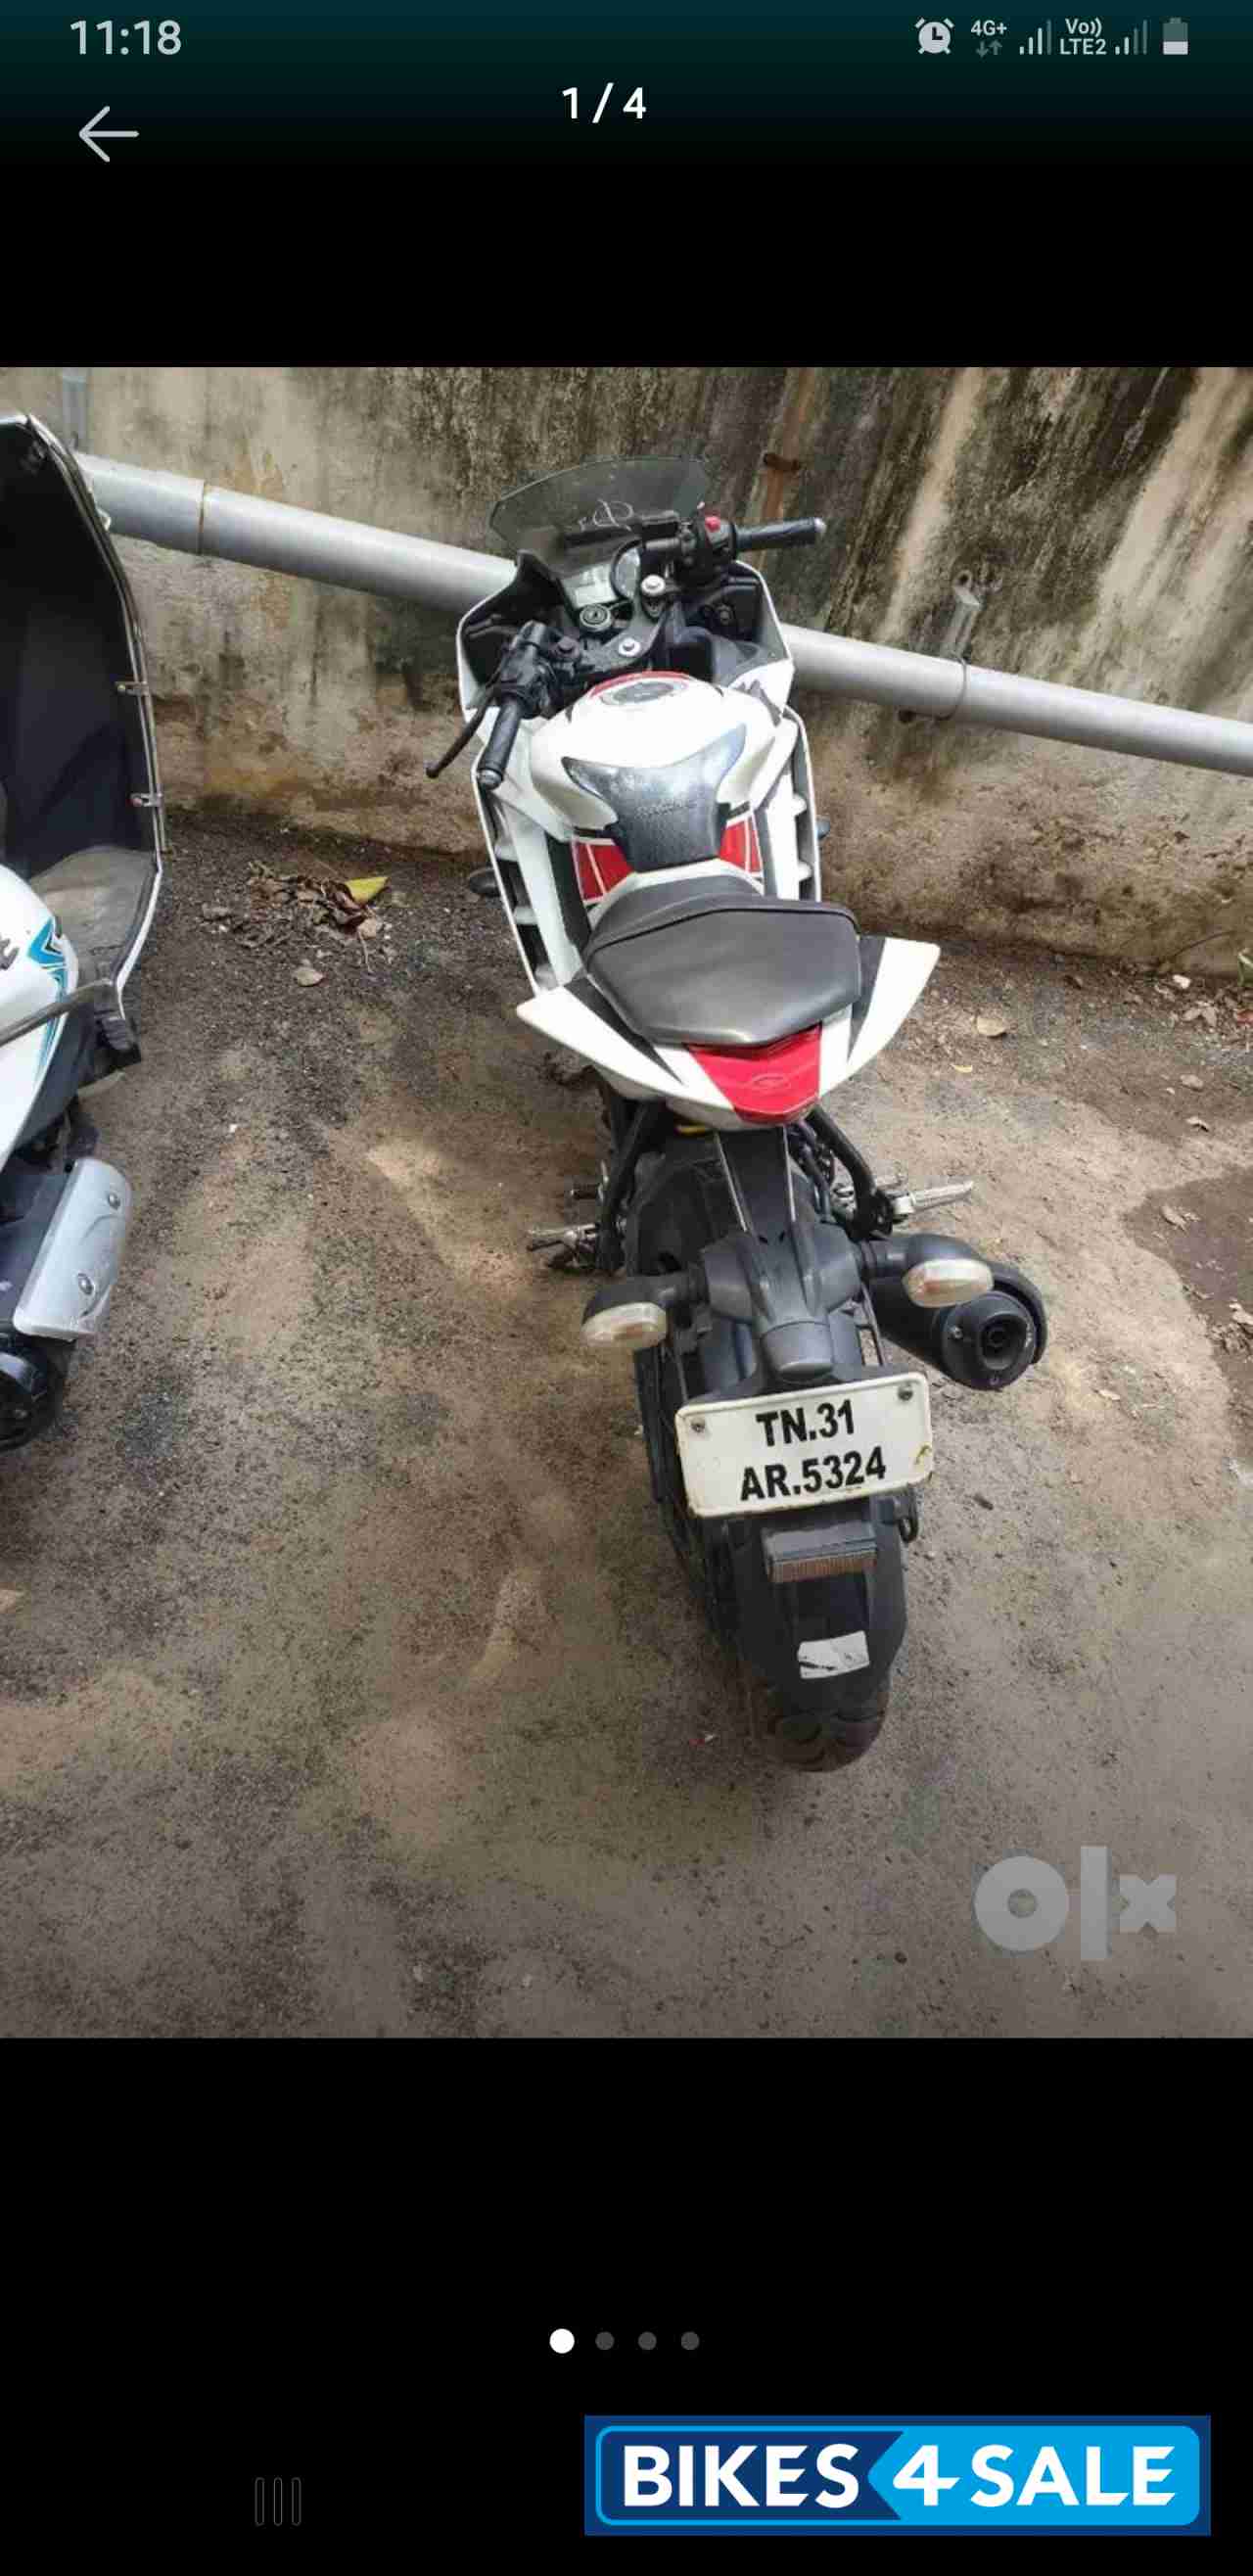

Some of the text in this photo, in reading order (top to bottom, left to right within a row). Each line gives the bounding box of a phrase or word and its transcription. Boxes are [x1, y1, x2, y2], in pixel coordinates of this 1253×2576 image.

[70, 20, 183, 56] 11:18
[970, 19, 1008, 37] 4G+
[1059, 37, 1107, 56] LTE2
[755, 1399, 856, 1447] TN.31
[740, 1446, 887, 1501] AR.5324
